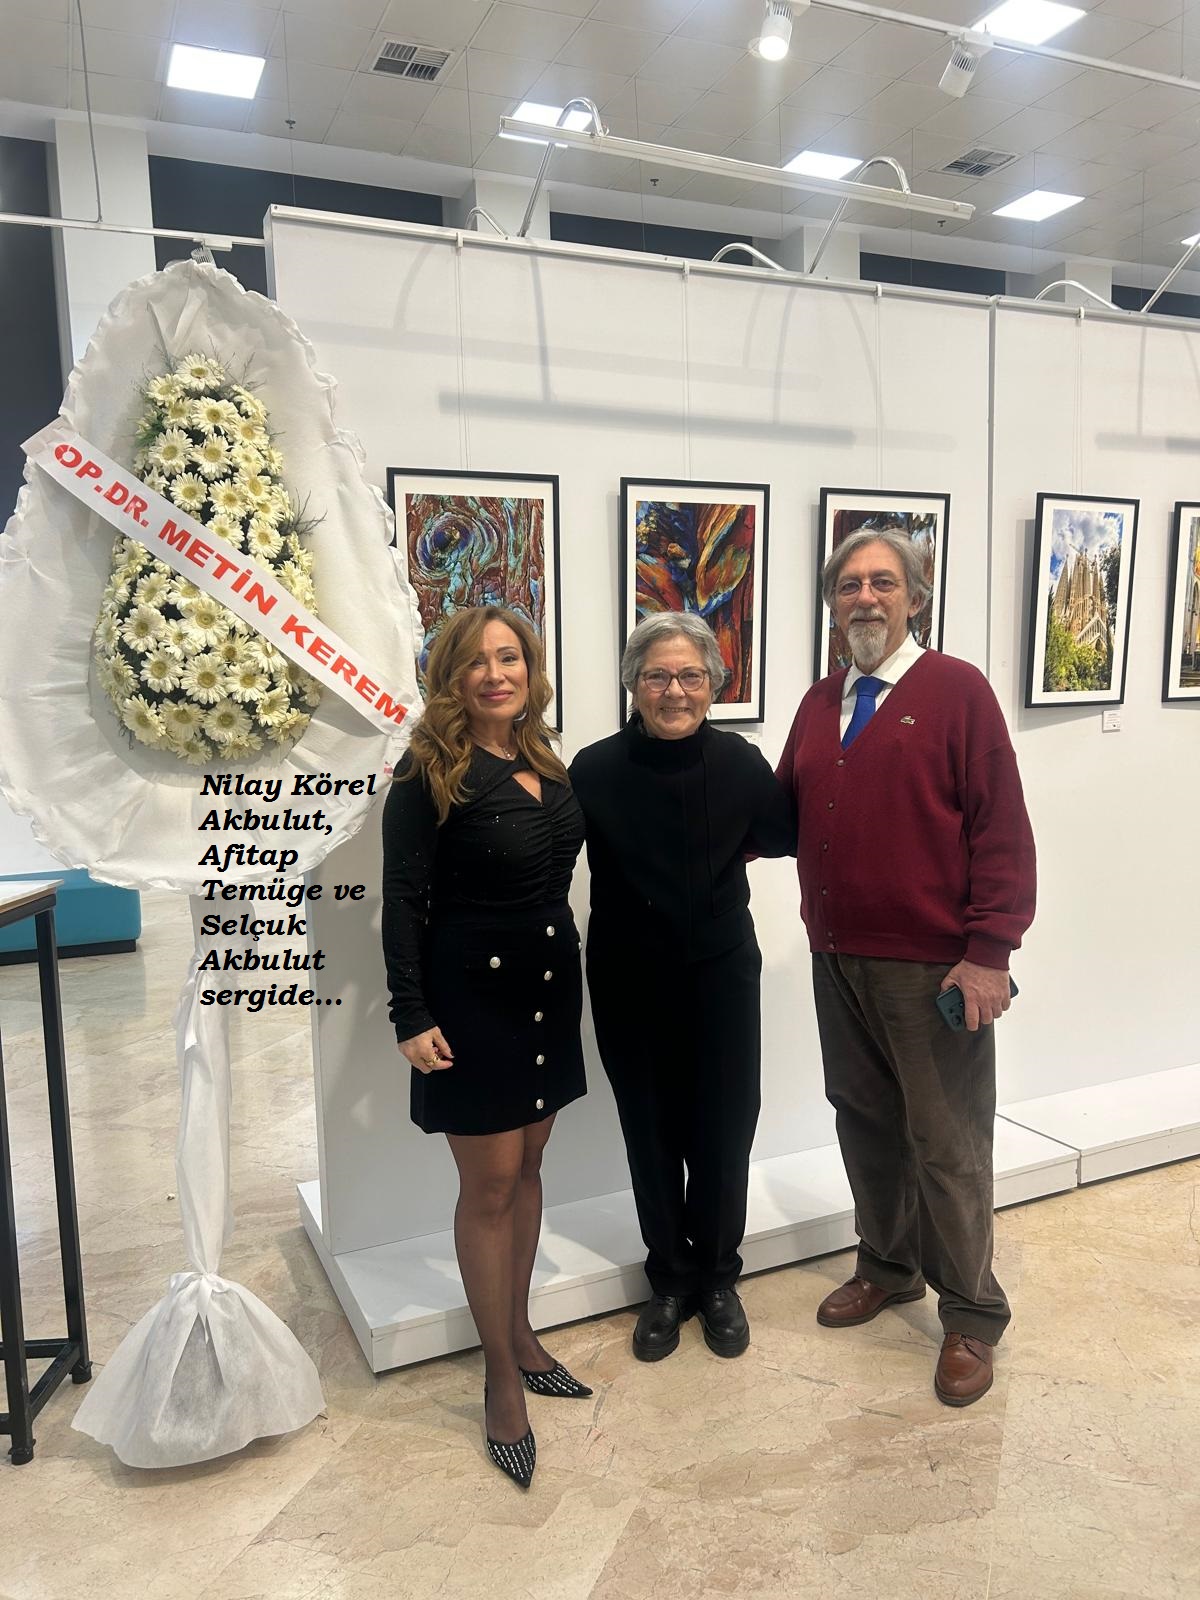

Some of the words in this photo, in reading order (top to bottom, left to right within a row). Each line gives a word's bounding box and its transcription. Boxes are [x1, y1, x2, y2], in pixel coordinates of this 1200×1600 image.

[54, 443, 148, 527] OP.DR.
[159, 519, 278, 615] METİN
[280, 614, 408, 725] KEREM
